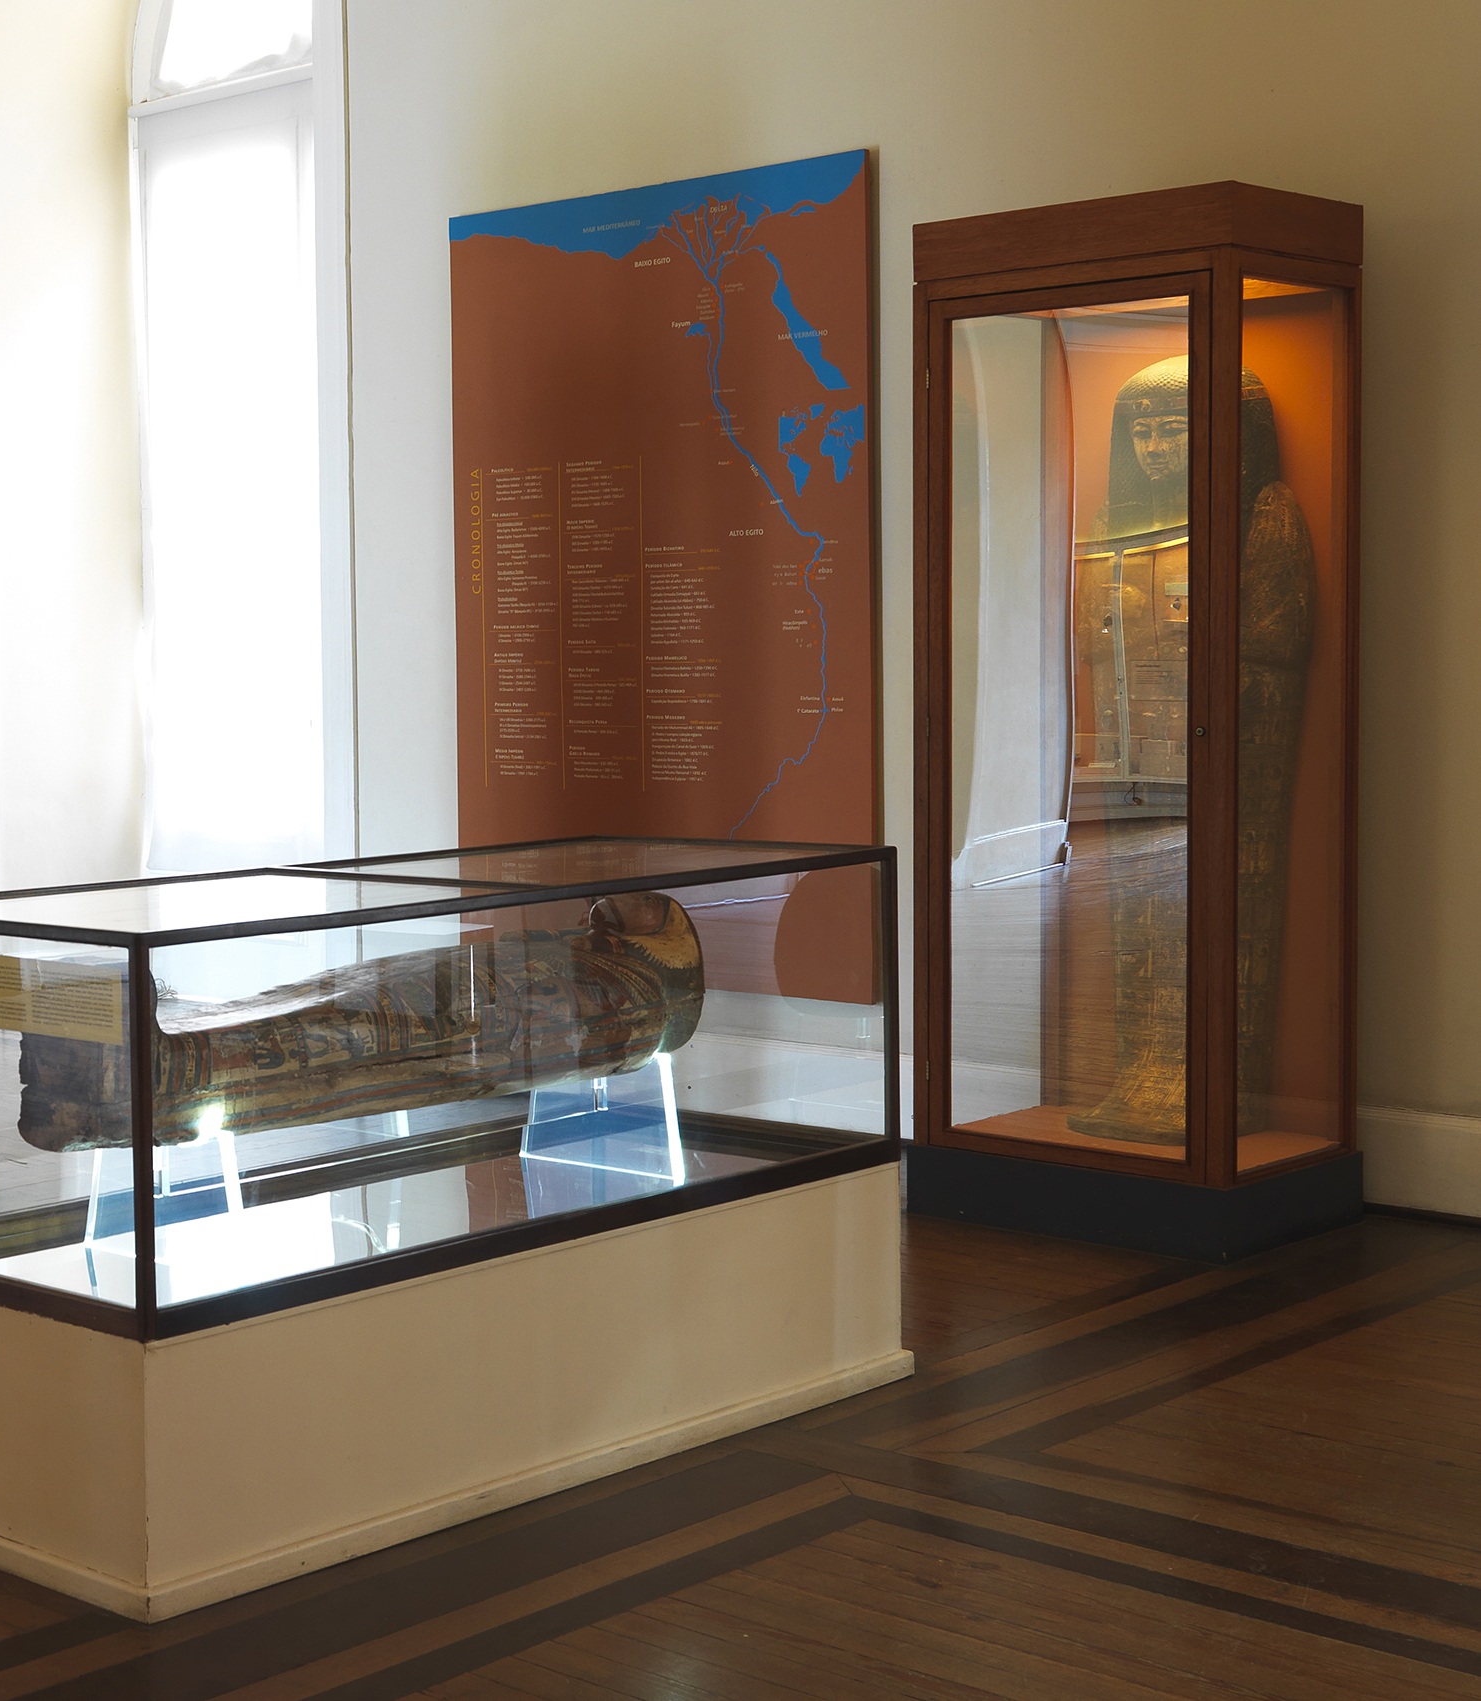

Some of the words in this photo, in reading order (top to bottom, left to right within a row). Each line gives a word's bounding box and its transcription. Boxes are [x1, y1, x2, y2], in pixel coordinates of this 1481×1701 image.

[582, 226, 596, 234] MAR
[634, 259, 652, 268] BAIXO
[653, 257, 671, 265] EGITO
[671, 321, 691, 329] Fayum
[793, 329, 828, 339] VERMELHO
[470, 468, 481, 594] CRONOLOGIA
[729, 529, 744, 537] ALTO
[745, 528, 764, 536] EGITO
